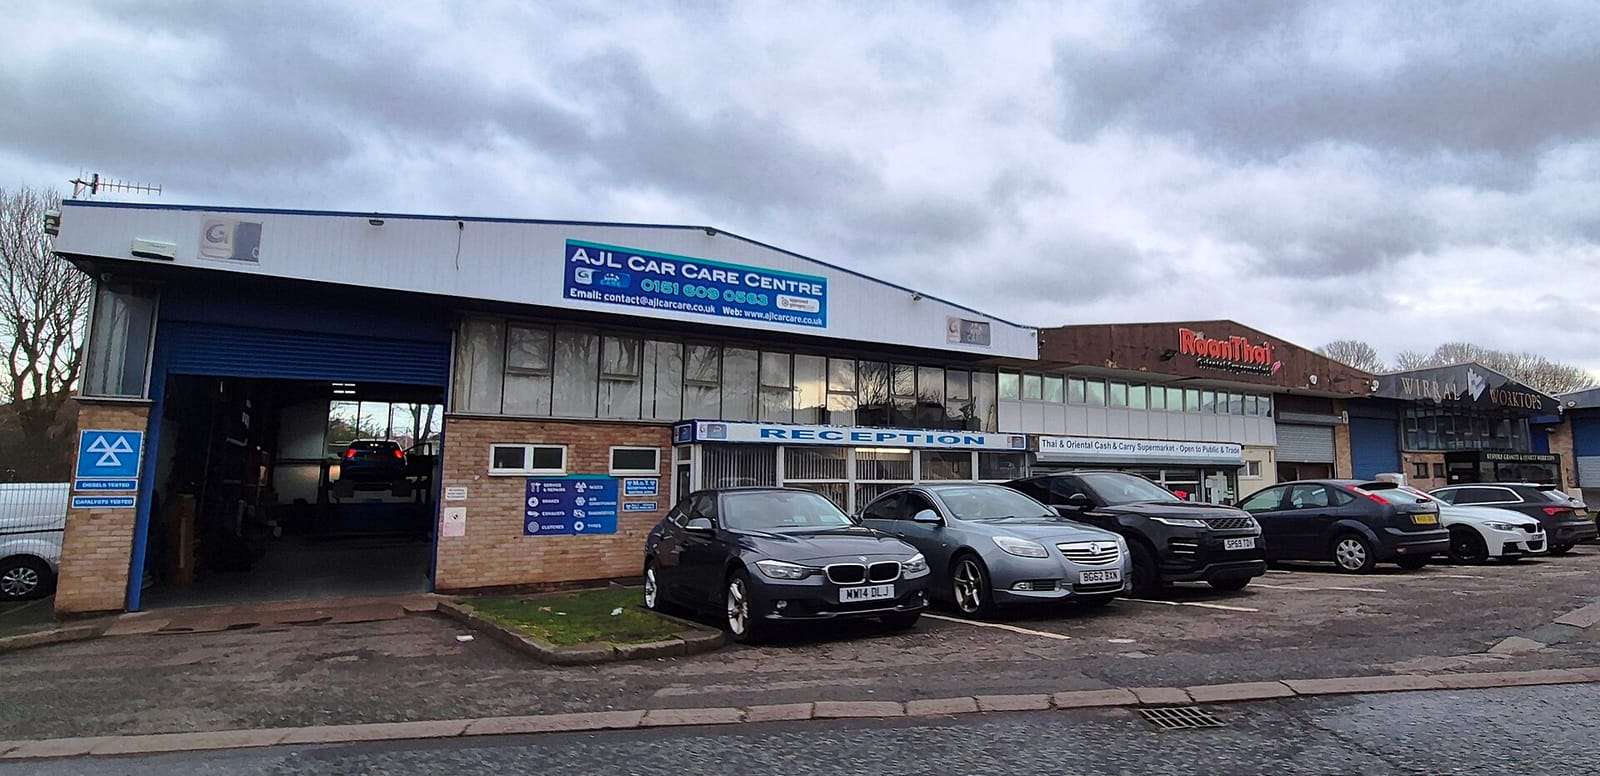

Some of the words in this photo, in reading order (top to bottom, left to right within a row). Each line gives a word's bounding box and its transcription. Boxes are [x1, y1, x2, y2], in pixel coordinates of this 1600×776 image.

[571, 248, 622, 269] AJL
[627, 256, 676, 276] CAR
[681, 264, 739, 285] CARE
[744, 273, 823, 296] CENTRE
[641, 278, 679, 296] 0151
[683, 284, 720, 300] 609
[723, 289, 769, 306] 0563
[570, 288, 602, 300] Email:
[604, 293, 716, 313] contact@ajlcarcare.co.uk
[722, 306, 742, 317] Web:
[744, 309, 823, 325] www.ajlcarcare.co.uk
[1400, 377, 1461, 401] WIRRAL
[1488, 388, 1543, 410] WORKTOPS
[760, 428, 985, 445] RECEPTION
[1042, 439, 1058, 448] Thai
[1059, 440, 1064, 448] &
[1066, 440, 1093, 449] Oriental
[1094, 441, 1111, 449] Cash
[1112, 442, 1117, 450] &
[1118, 442, 1136, 452] Carry
[1137, 442, 1175, 452] Supermarket
[1179, 444, 1195, 453] Open
[1195, 445, 1201, 453] to
[1202, 445, 1219, 453] Public
[1225, 446, 1240, 454] Trade
[871, 586, 889, 597] DLJ
